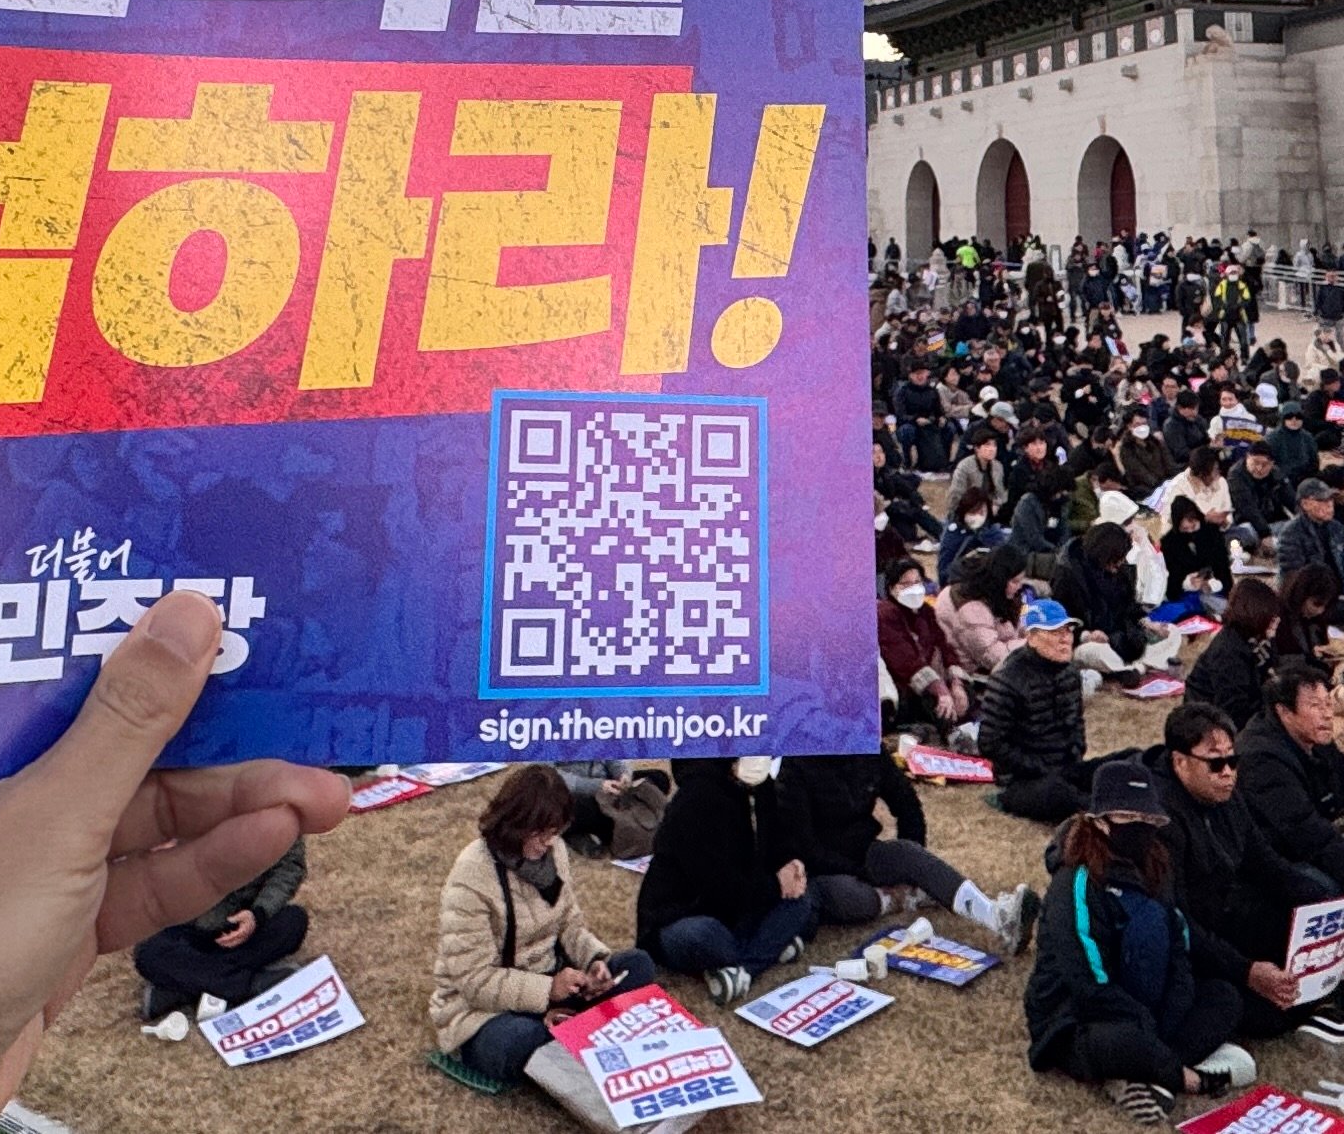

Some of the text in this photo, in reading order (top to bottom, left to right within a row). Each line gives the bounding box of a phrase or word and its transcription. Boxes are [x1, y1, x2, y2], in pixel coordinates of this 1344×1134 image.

[24, 526, 132, 585] 더불어
[479, 706, 768, 750] sign.theminjoo.kr
[607, 1063, 668, 1097] OUT!
[630, 1077, 737, 1119] 국정농단
